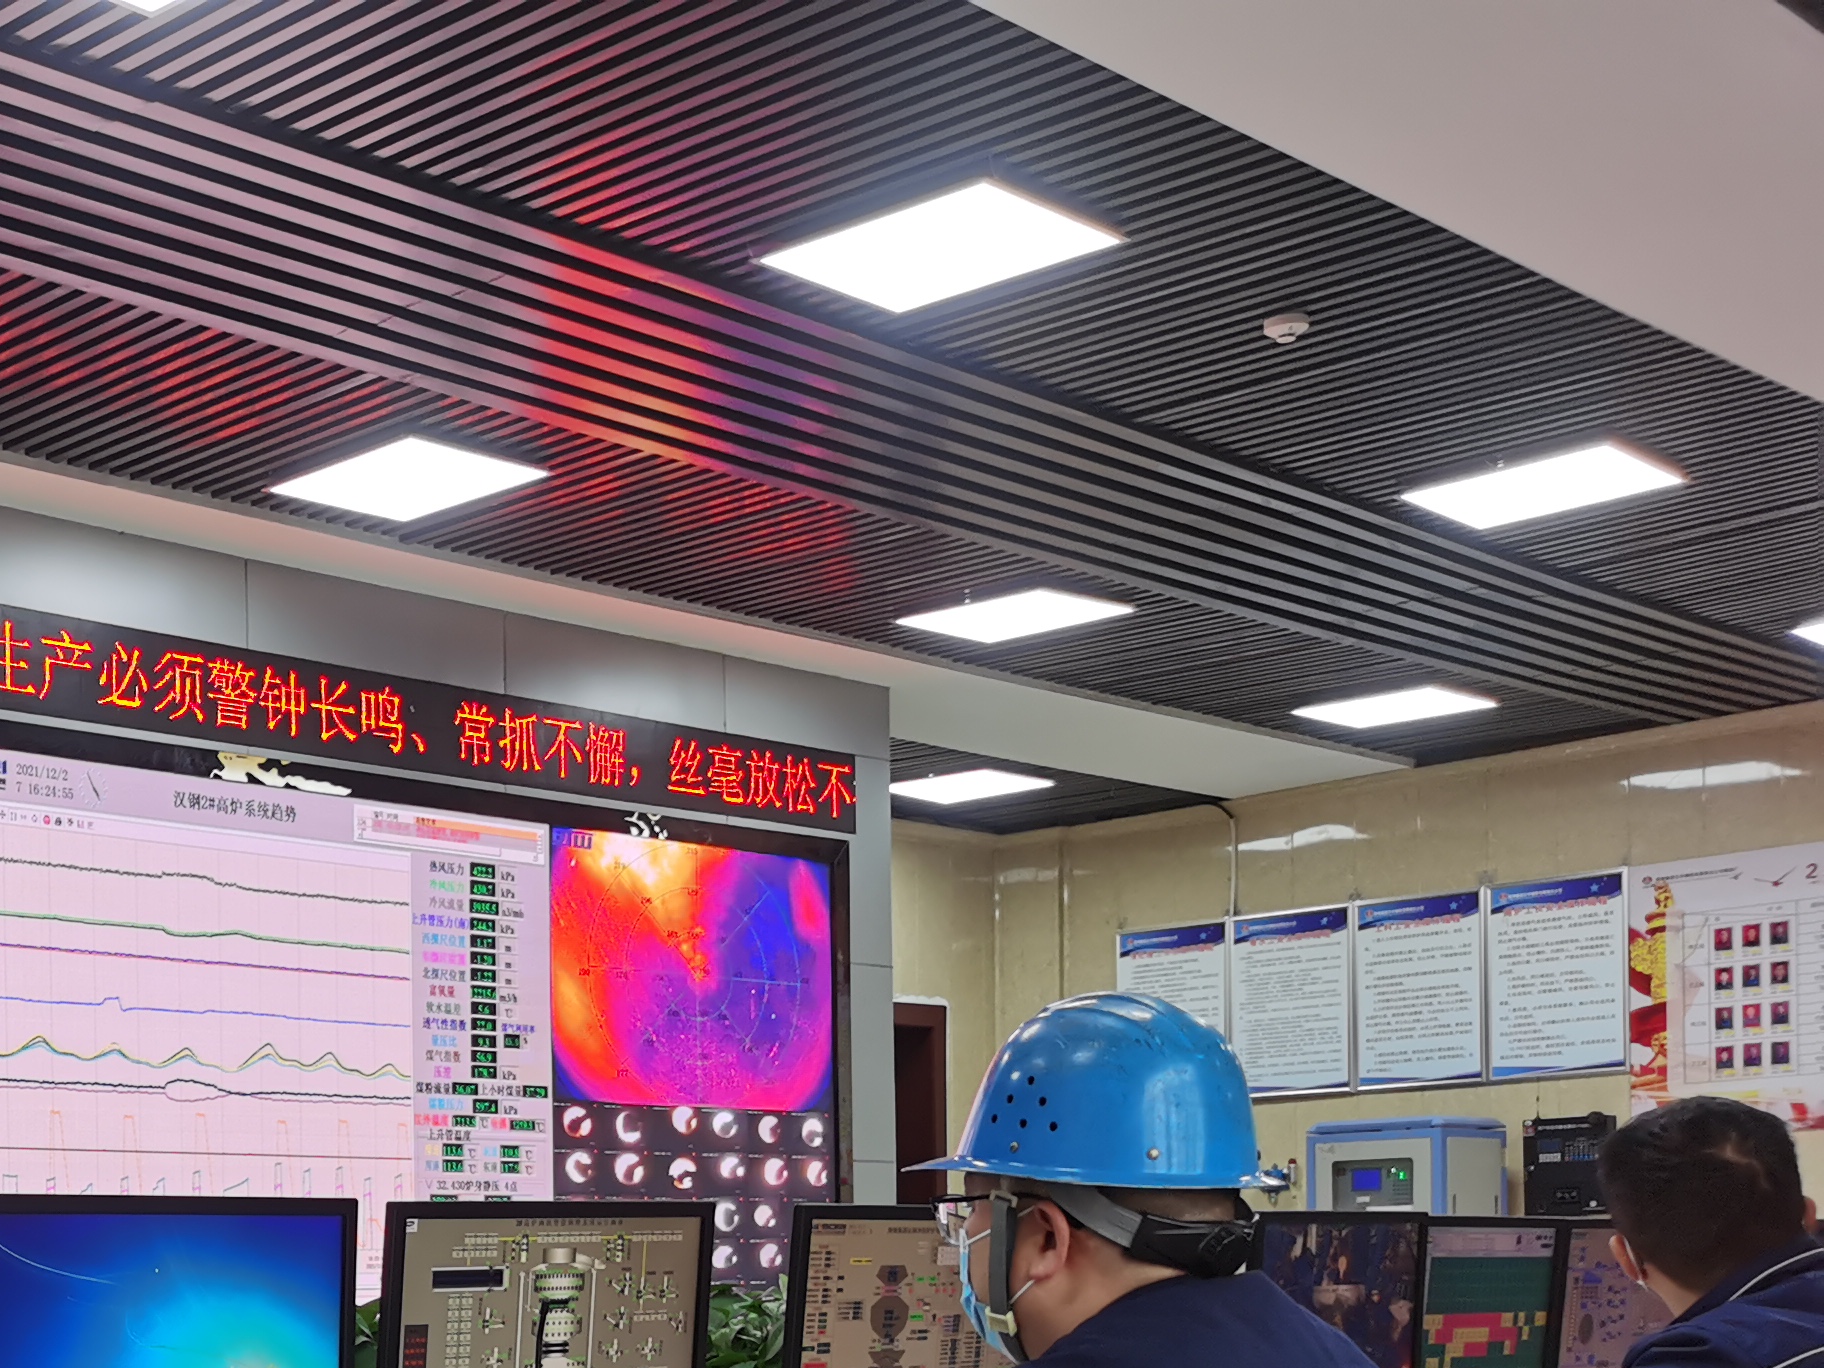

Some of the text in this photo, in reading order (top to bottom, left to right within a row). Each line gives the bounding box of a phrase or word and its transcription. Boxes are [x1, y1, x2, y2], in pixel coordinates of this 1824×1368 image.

[16, 763, 69, 782] 2021/12/2
[15, 782, 74, 800] 7 16:24:55
[173, 790, 297, 823] 汉钢2#高炉系统趋势
[501, 871, 515, 882] kPa
[501, 888, 515, 899] kPa
[500, 924, 514, 935] kPa
[502, 1071, 516, 1081] kPa
[503, 1105, 518, 1115] kPa
[504, 1181, 518, 1192] 4点
